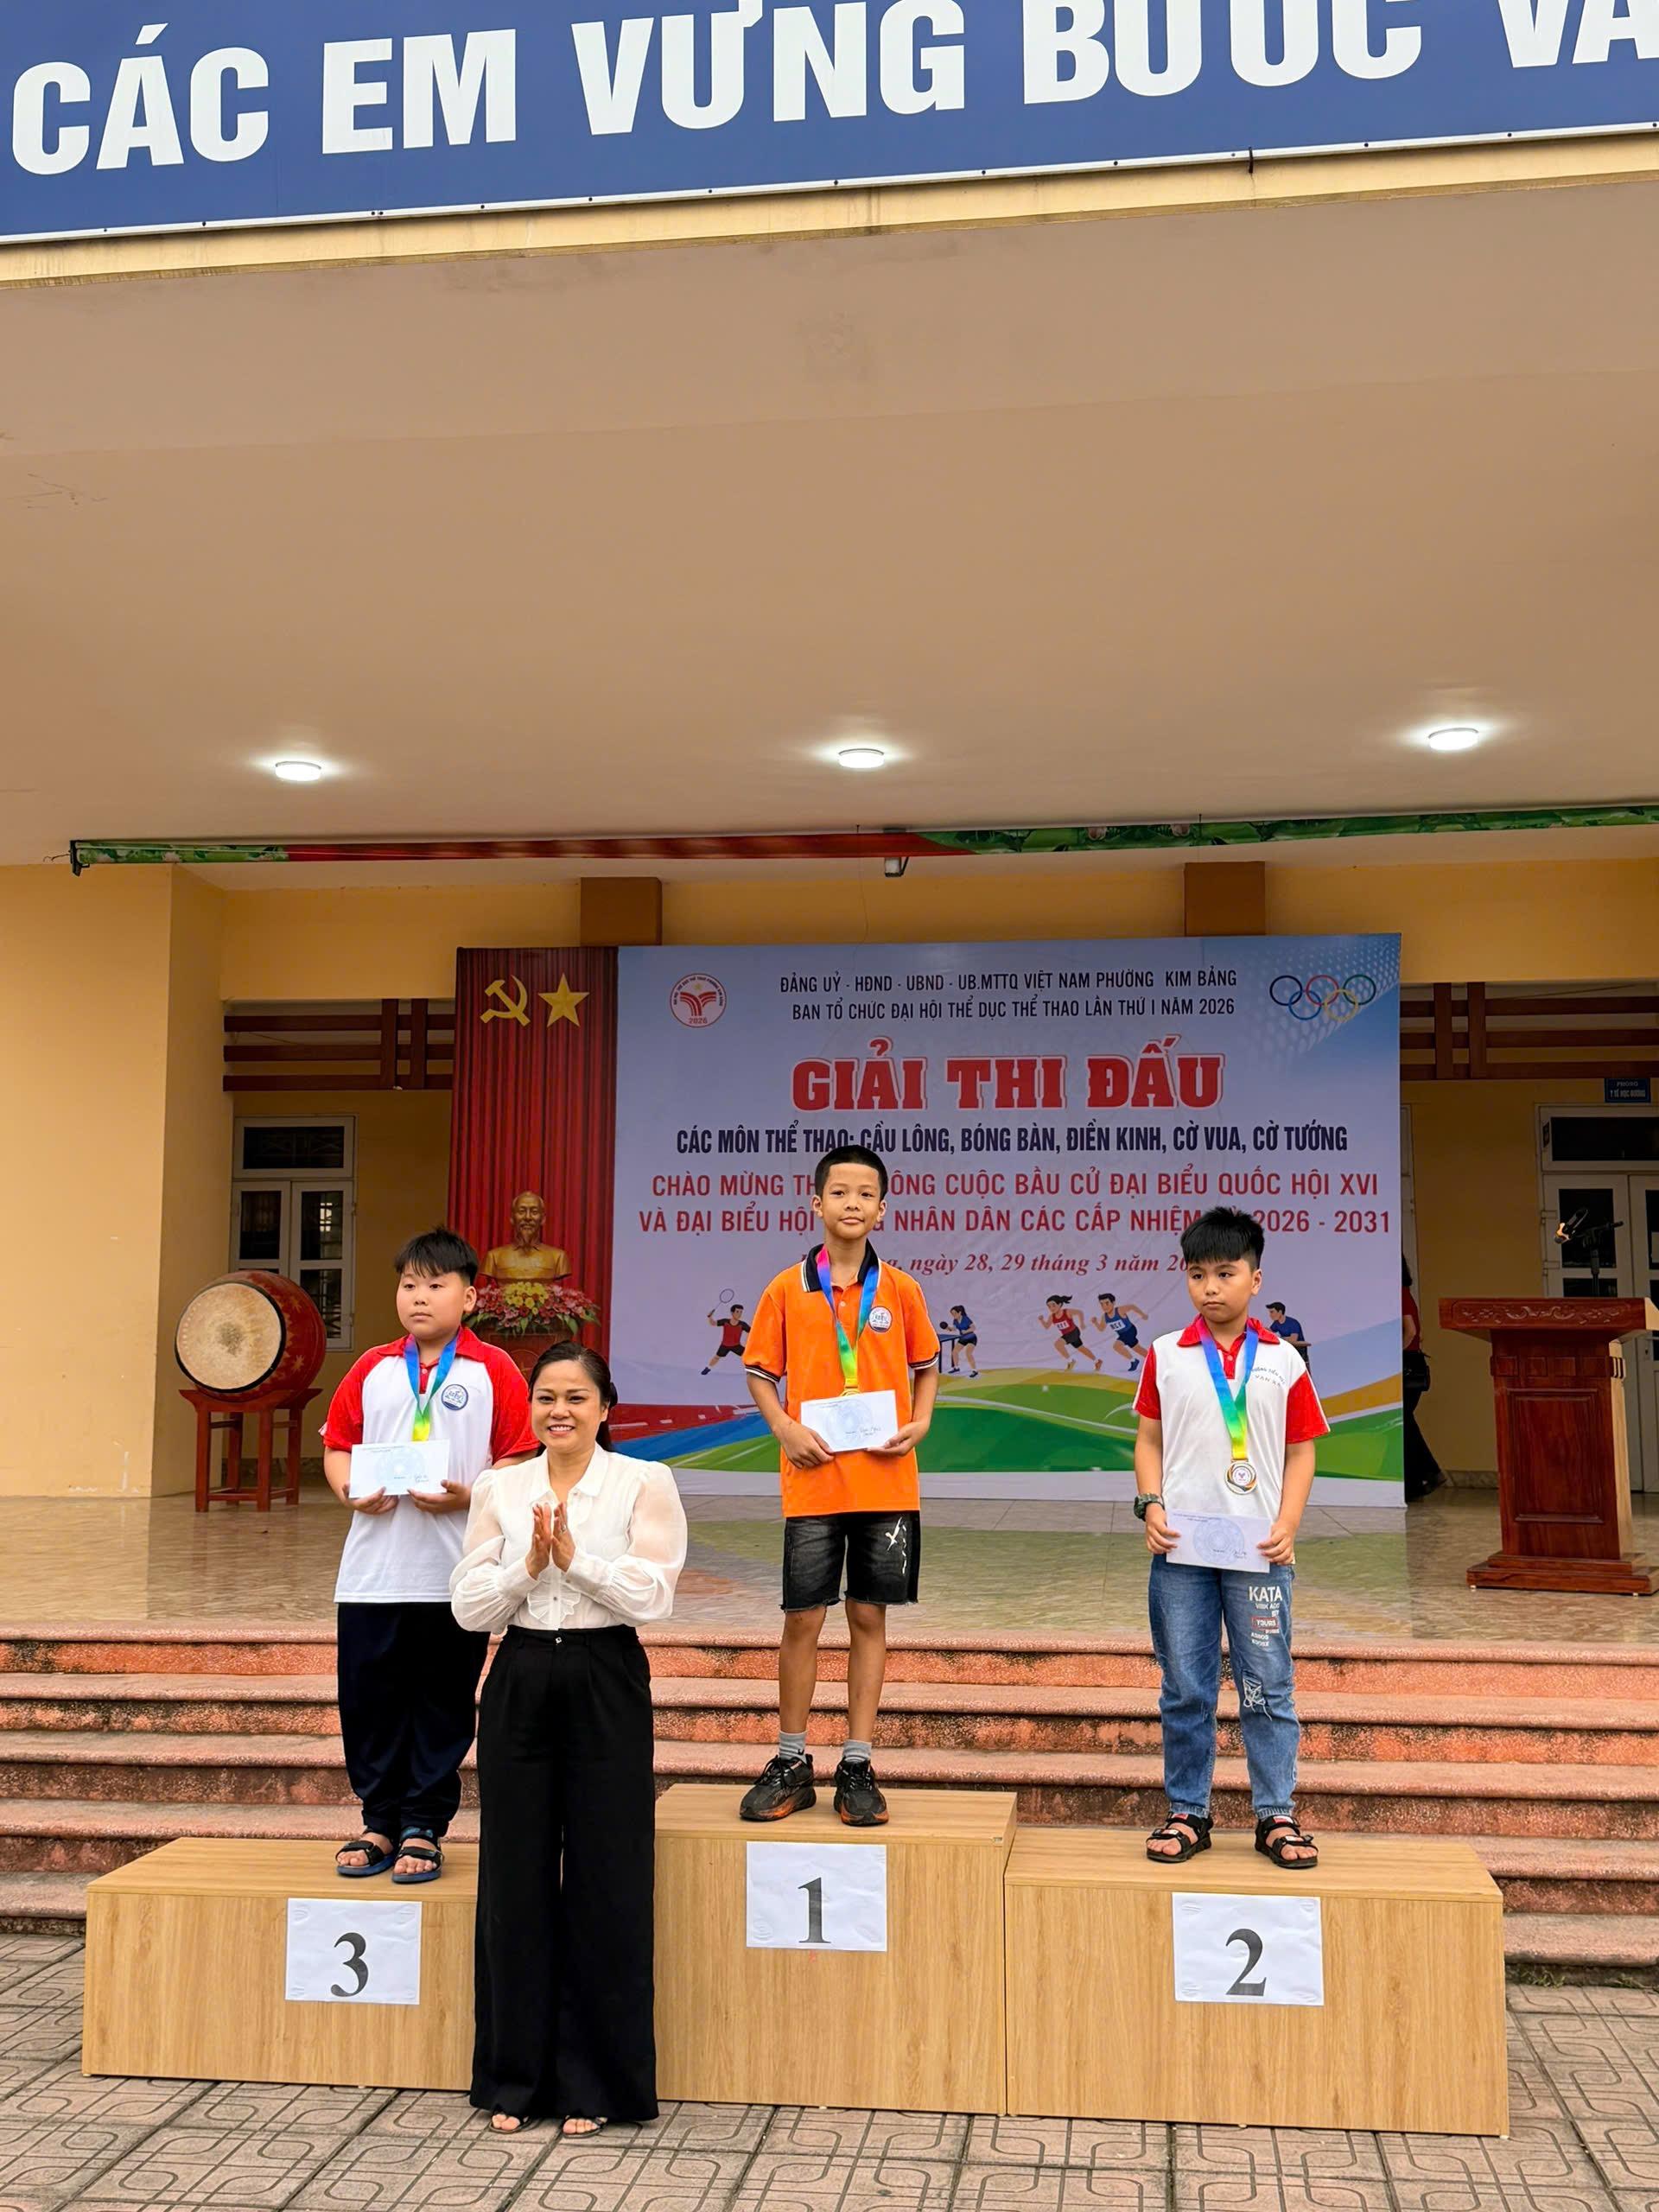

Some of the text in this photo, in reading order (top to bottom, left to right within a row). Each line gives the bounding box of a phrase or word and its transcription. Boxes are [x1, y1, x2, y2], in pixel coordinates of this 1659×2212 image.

[12, 22, 270, 175] CÁC
[322, 29, 517, 154] EM
[781, 972, 817, 992] ĐẢNG
[823, 971, 841, 992] UỶ
[855, 976, 892, 991] HĐND
[907, 975, 944, 990] UBND
[959, 974, 1018, 989] UB.MTTQ
[1024, 972, 1052, 992] VIỆT
[1059, 973, 1090, 988] NAM
[1096, 969, 1154, 988] PHƯỜNG
[1166, 971, 1191, 987] KIM
[1198, 966, 1236, 986] BẢNG
[793, 994, 1234, 1022] BAN TỔ CHỨC ĐẠI HỘI THỂ DỤC THỂ THAO LẦN THỨ I NĂM 2026
[793, 1034, 1225, 1110] GIẢI THI ĐẤU
[677, 1125, 712, 1154] CÁC
[718, 1125, 759, 1153] MÔN
[766, 1120, 798, 1153] THỂ
[861, 1121, 895, 1153] CẦU
[903, 1123, 954, 1154] LÔNG,
[961, 1123, 1010, 1151] BÓNG
[1018, 1122, 1060, 1154] BÀN,
[1066, 1119, 1109, 1150] ĐIỀN
[1116, 1127, 1166, 1154] KINH,
[1173, 1120, 1198, 1150] CỜ
[1205, 1127, 1246, 1154] VUA,
[1254, 1120, 1279, 1150] CỜ
[1284, 1119, 1347, 1151] TƯỚNG
[653, 1171, 709, 1196] CHÀO
[721, 1171, 783, 1196] MỪNG
[891, 1170, 934, 1195] ÔNG
[946, 1173, 1004, 1198] CUỘC
[1016, 1166, 1059, 1194] BẦU
[1071, 1166, 1102, 1195] CỬ
[1110, 1173, 1146, 1198] ĐẠI
[1159, 1163, 1207, 1194] BIỂU
[1219, 1166, 1281, 1198] QUỐC
[1292, 1169, 1329, 1199] HỘI
[1340, 1173, 1376, 1195] XVI
[639, 1207, 666, 1231] VÀ
[677, 1211, 711, 1236] ĐẠI
[722, 1201, 768, 1231] BIỂU
[779, 1206, 814, 1236] HỘI
[895, 1206, 954, 1230] NHÂN
[966, 1205, 1010, 1230] DÂN
[1021, 1205, 1065, 1230] CÁC
[1076, 1202, 1120, 1230] CẤP
[1334, 1211, 1388, 1232] 2031
[910, 1254, 958, 1275] ngày
[964, 1254, 993, 1273] 28,
[1001, 1254, 1025, 1270] 29
[1031, 1254, 1090, 1275] tháng
[1096, 1255, 1108, 1271] 3
[1115, 1255, 1159, 1270] năm
[1249, 1586, 1282, 1602] KATA
[798, 1878, 831, 1943] 1
[331, 1932, 368, 1997] 3
[1225, 1928, 1267, 1996] 2
